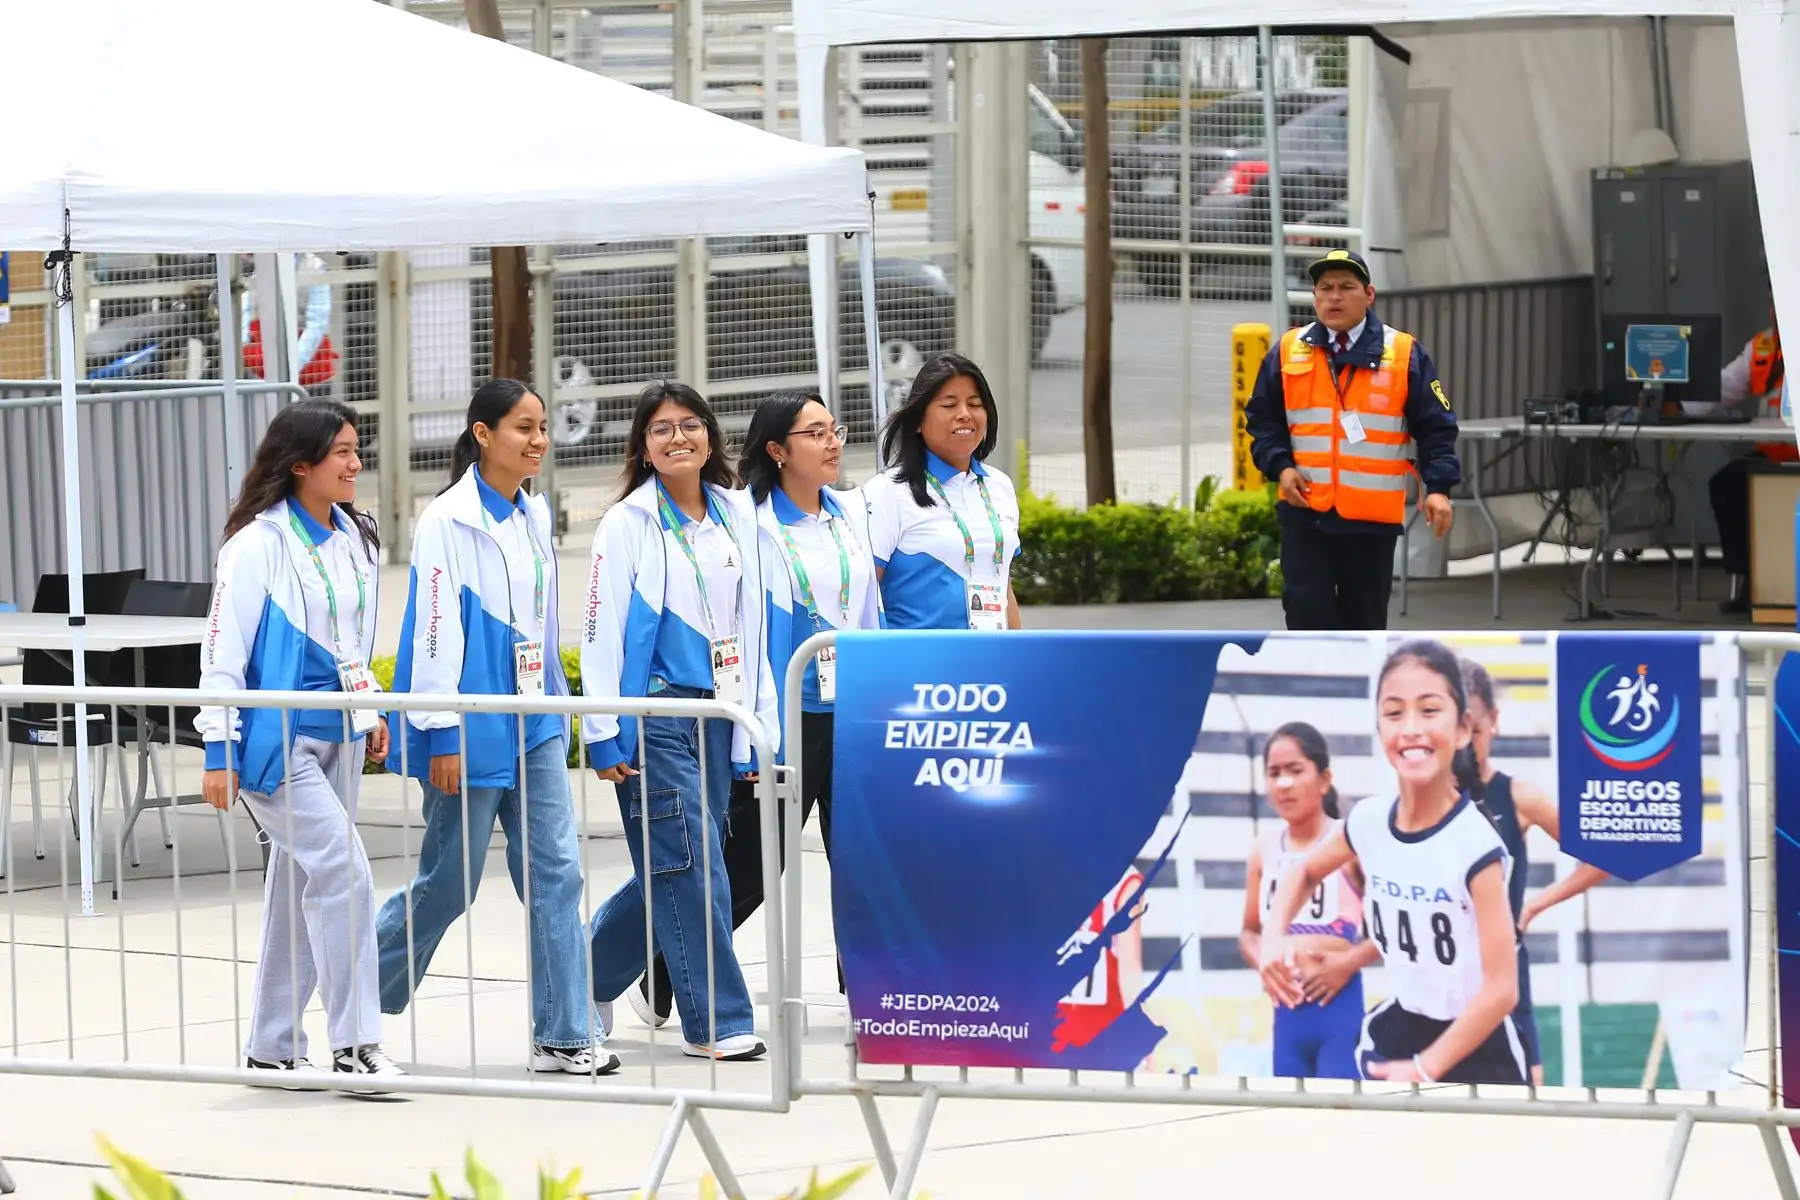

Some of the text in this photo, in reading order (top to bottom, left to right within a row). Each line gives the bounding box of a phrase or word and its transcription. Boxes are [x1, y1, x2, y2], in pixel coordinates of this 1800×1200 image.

[588, 553, 603, 643] Ayacucho2024
[430, 566, 443, 659] Ayacucho2024
[913, 683, 1007, 713] TODO
[885, 720, 1034, 750] EMPIEZA
[913, 752, 1004, 793] AQUÍ
[1580, 780, 1682, 801] JUEGOS
[1580, 801, 1682, 817] ESCOLARES
[1580, 817, 1682, 832] DEPORTIVOS
[1580, 831, 1682, 843] Y PARADEPORTIVOS
[1372, 899, 1457, 966] 448
[880, 993, 1001, 1013] #JEDPA2024
[852, 1018, 1030, 1041] #TodoEmpiezaAquí
